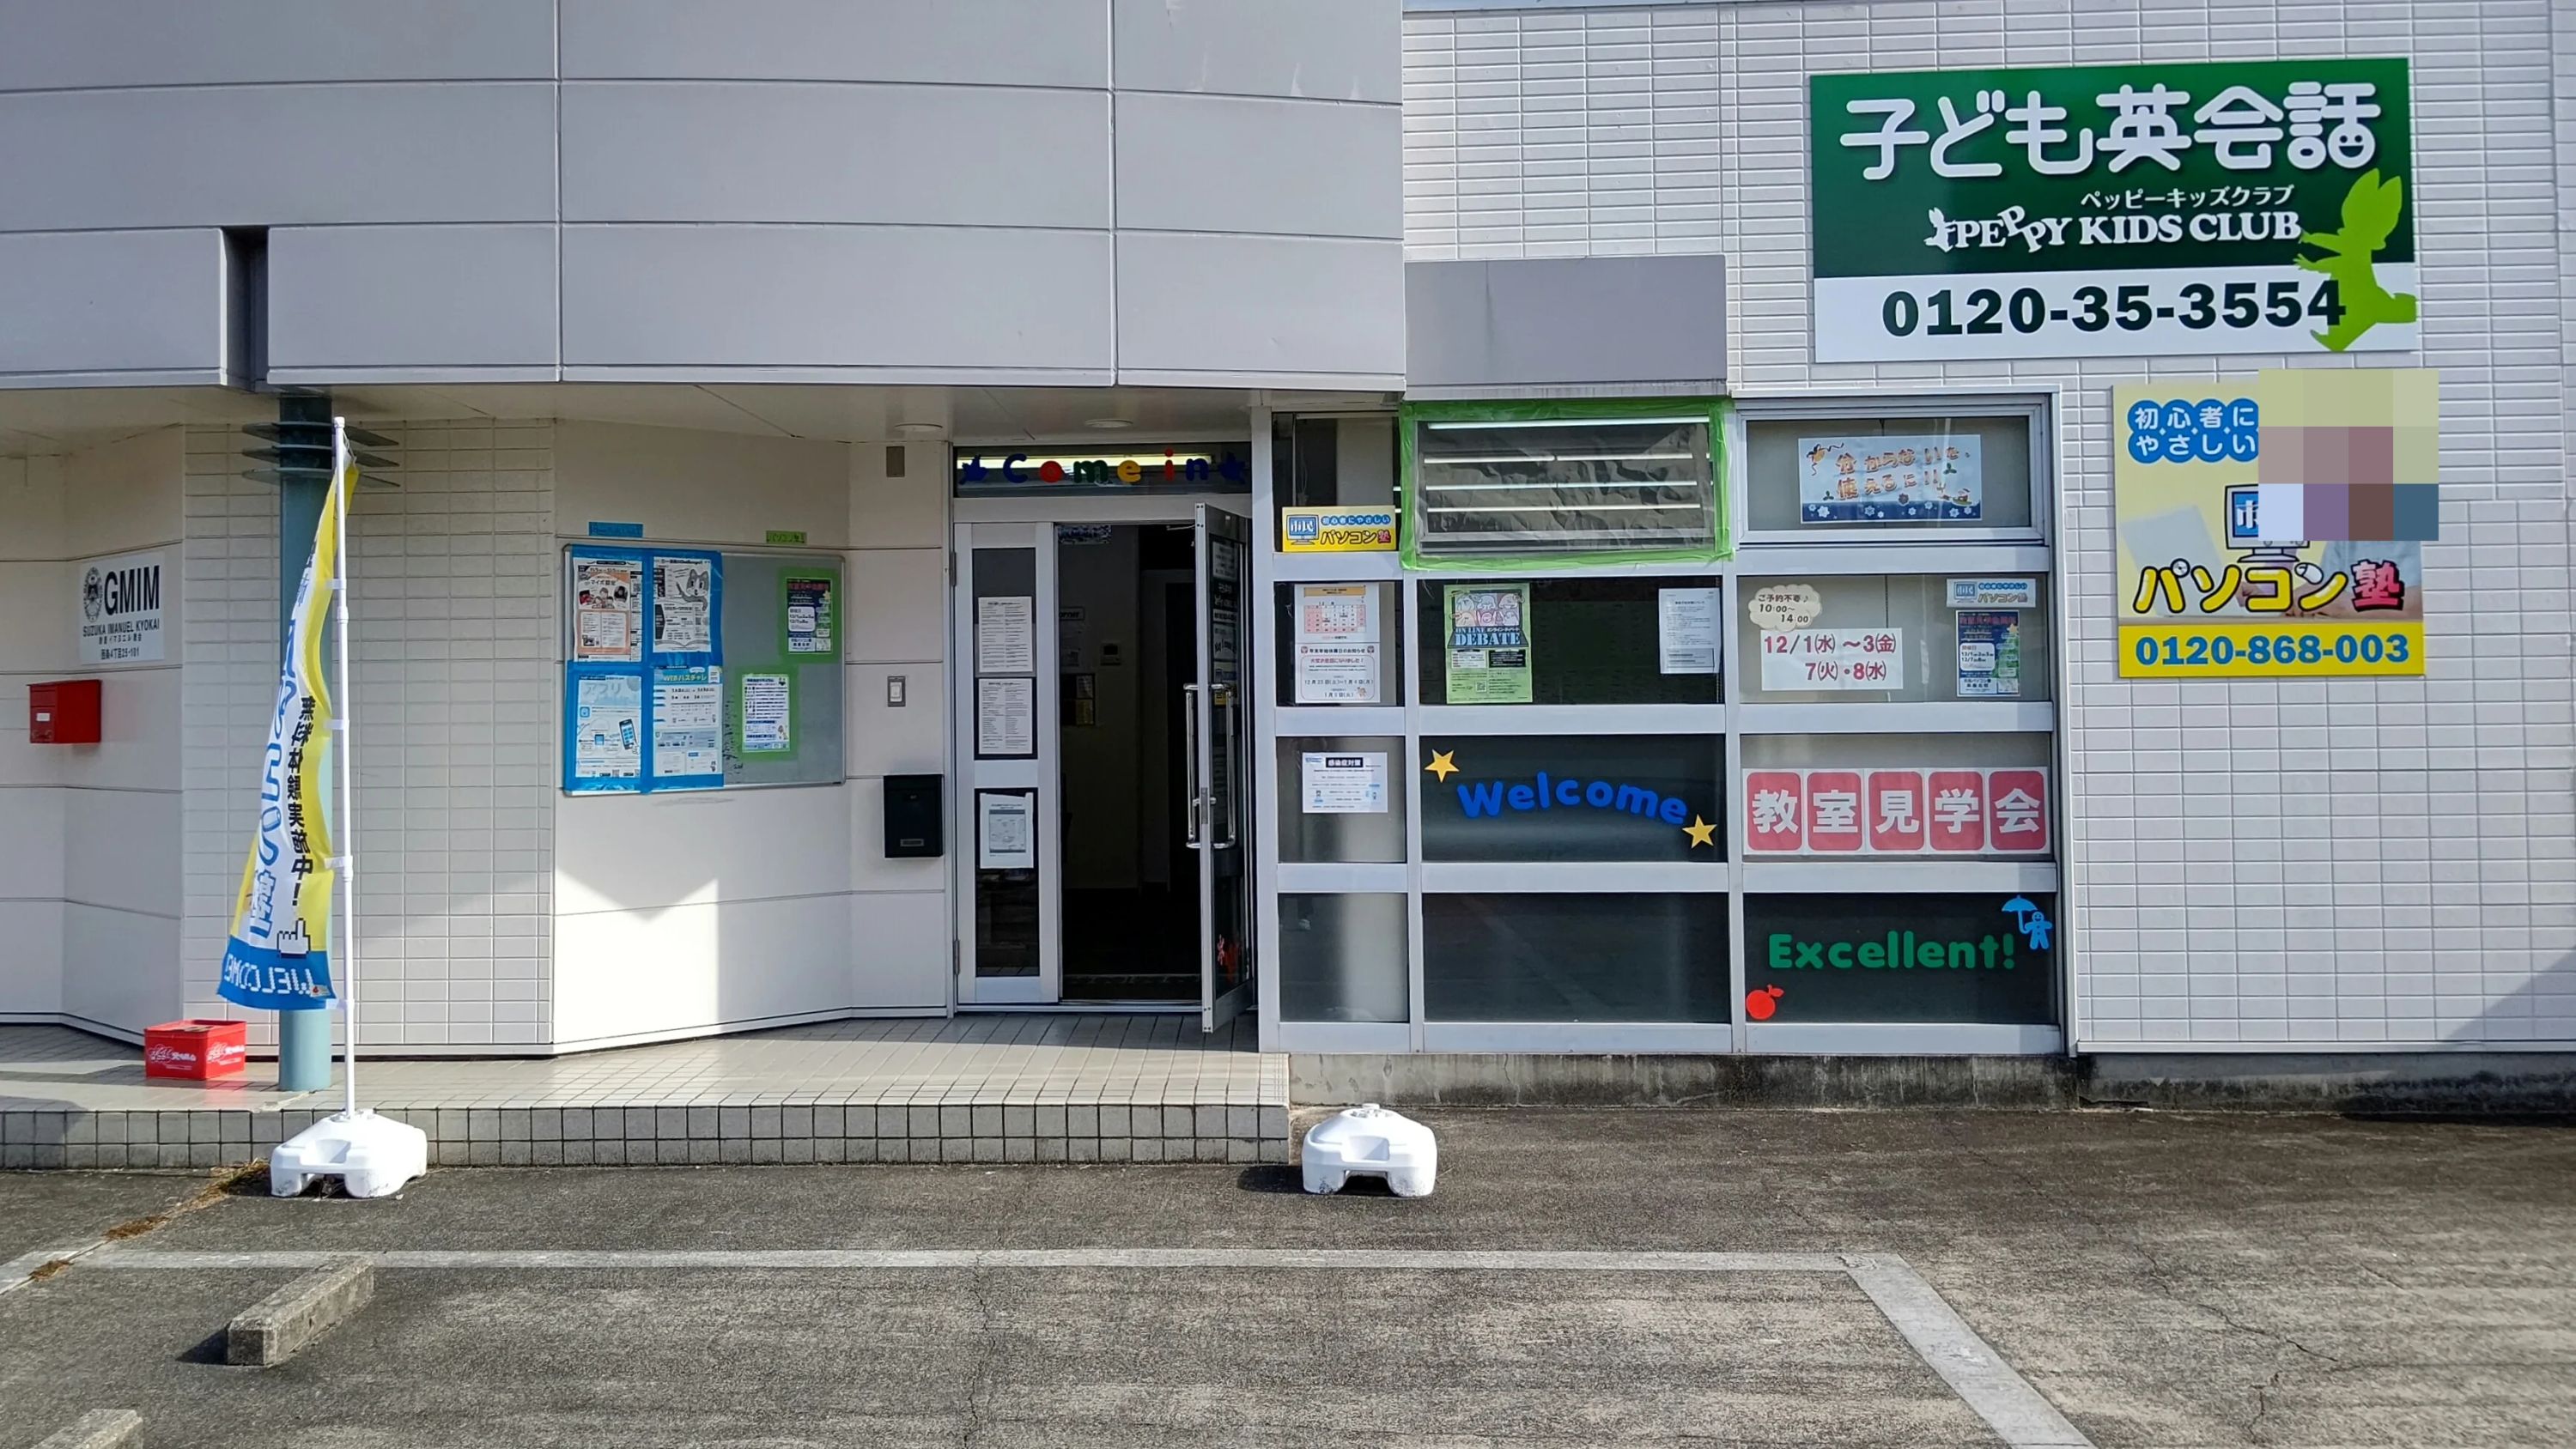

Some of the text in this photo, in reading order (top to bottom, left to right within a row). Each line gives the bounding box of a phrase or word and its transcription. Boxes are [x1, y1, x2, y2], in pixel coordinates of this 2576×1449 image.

[1839, 81, 2381, 180] 子ども英会話
[2081, 184, 2294, 209] ペッピーキッズクラブ
[1954, 204, 2301, 254] PEPPY KIDS CLUB
[1882, 280, 2347, 337] 0120-35-3554
[2135, 406, 2256, 429] 初心者に
[2136, 434, 2257, 456] やさしい
[1002, 447, 1209, 484] Come in
[1321, 529, 1391, 545] パソコン塾
[104, 565, 160, 615] GMIM
[2133, 558, 2404, 614] パソコン塾
[136, 617, 160, 632] KYOKAI
[1455, 632, 1521, 646] DEBATE
[2136, 634, 2409, 665] 0120-868-003
[1457, 771, 1689, 825] Welcome
[1752, 788, 2040, 834] 教室見学会
[1768, 931, 2015, 969] Excellent!
